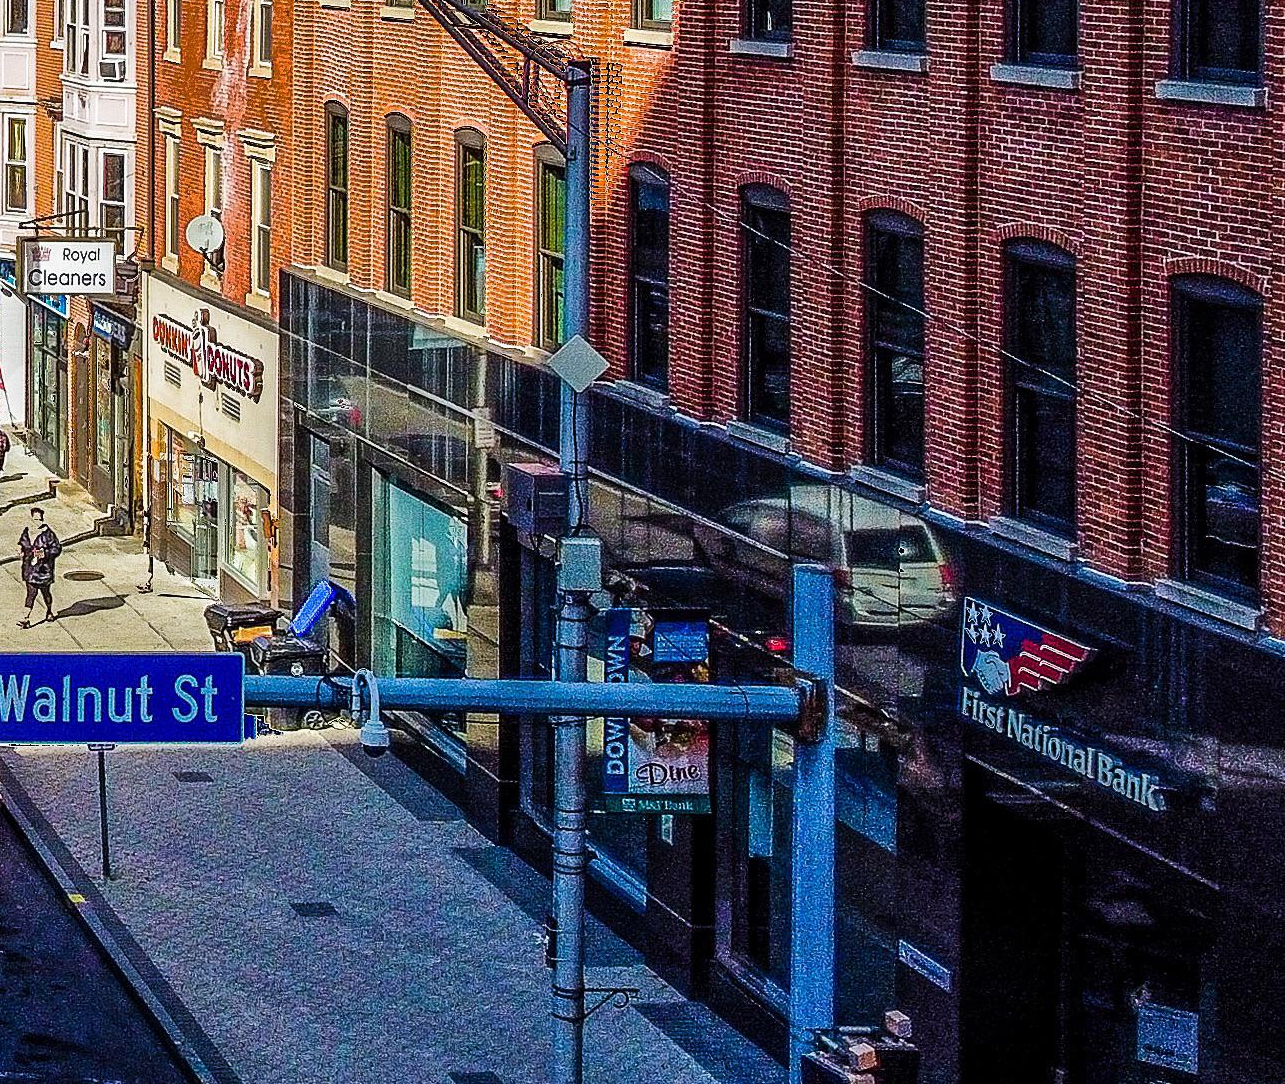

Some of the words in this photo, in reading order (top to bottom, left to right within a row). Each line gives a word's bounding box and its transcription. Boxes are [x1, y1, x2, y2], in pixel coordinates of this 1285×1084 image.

[28, 269, 106, 286] Cleaners
[62, 248, 101, 264] Royal
[206, 344, 250, 392] DONUTS
[172, 674, 218, 723] St
[606, 636, 626, 775] DOWWN
[961, 687, 1006, 733] First
[1007, 708, 1095, 779] National
[1097, 752, 1166, 811] Bank
[636, 762, 701, 786] Dine
